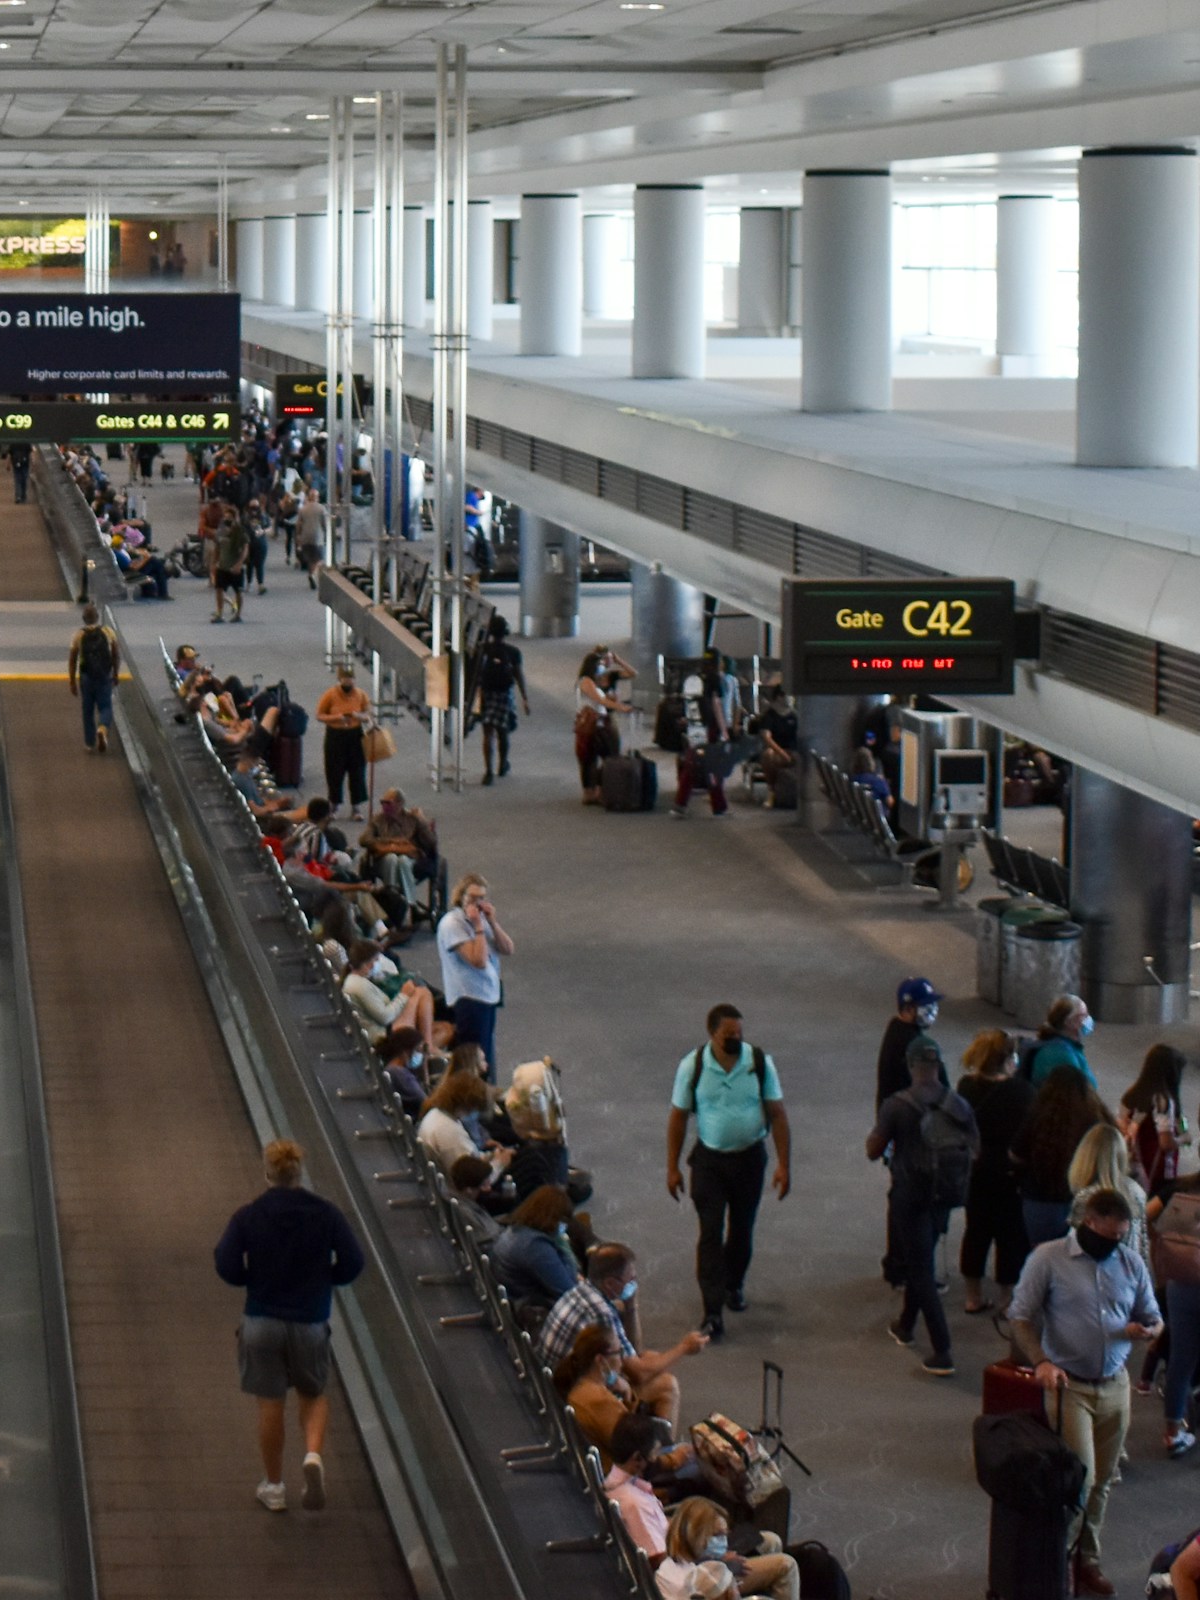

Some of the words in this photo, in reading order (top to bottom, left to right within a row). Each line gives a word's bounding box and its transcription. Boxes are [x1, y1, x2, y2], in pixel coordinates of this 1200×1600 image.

[16, 311, 31, 327] a
[36, 306, 83, 327] mile
[89, 306, 146, 332] high.
[27, 369, 61, 381] Higher
[63, 370, 111, 381] corporate
[114, 369, 136, 379] card
[138, 369, 164, 379] limits
[166, 369, 185, 379] and
[187, 369, 230, 379] rewards.
[293, 384, 314, 394] Gate
[6, 414, 32, 428] C99
[96, 414, 135, 428] Gates
[138, 414, 162, 428] C44
[166, 414, 177, 428] &
[181, 414, 206, 428] C46
[836, 608, 884, 628] Gate
[902, 600, 973, 636] C42
